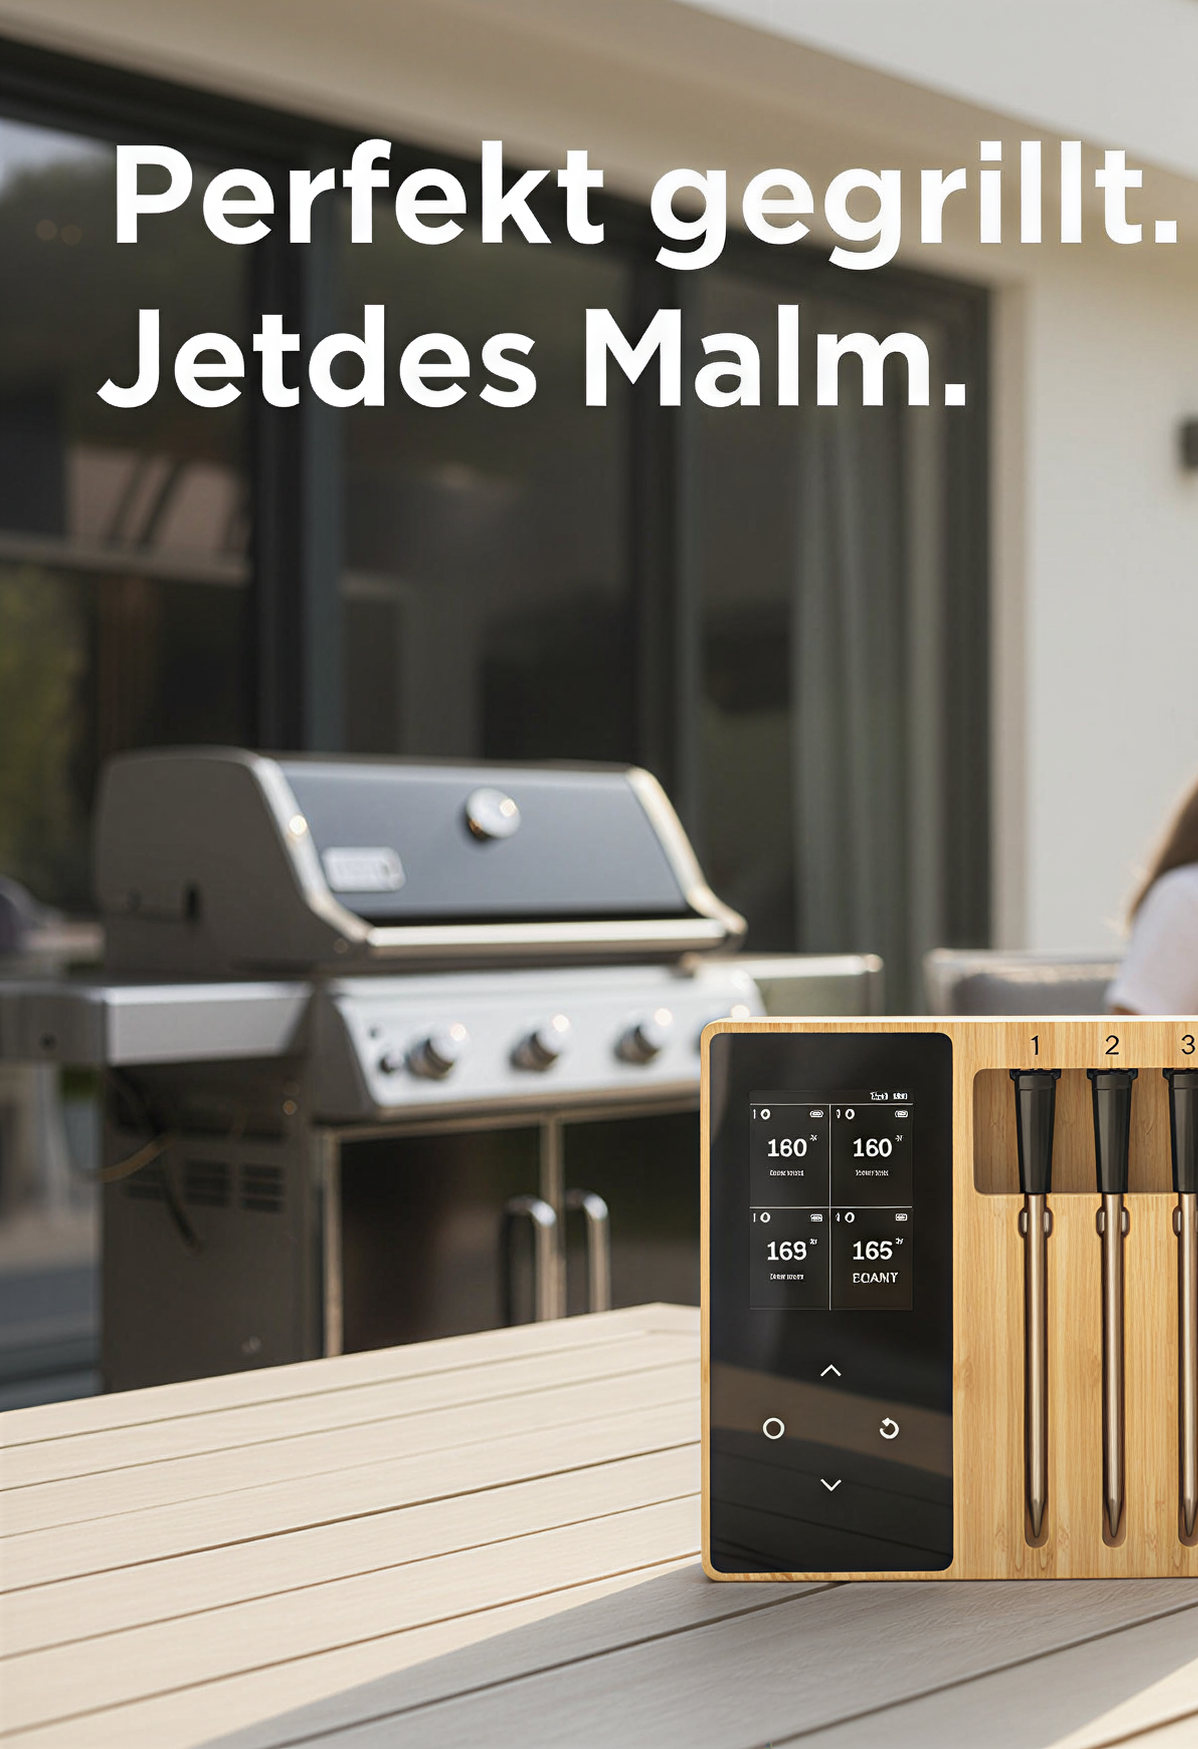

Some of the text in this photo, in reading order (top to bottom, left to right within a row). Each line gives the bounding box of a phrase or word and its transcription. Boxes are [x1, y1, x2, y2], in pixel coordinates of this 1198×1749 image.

[1030, 1035, 1039, 1056] 1
[1105, 1034, 1120, 1055] 2
[1181, 1034, 1196, 1055] 3
[767, 1137, 808, 1158] 160
[853, 1137, 893, 1158] 160
[852, 1240, 893, 1261] 165
